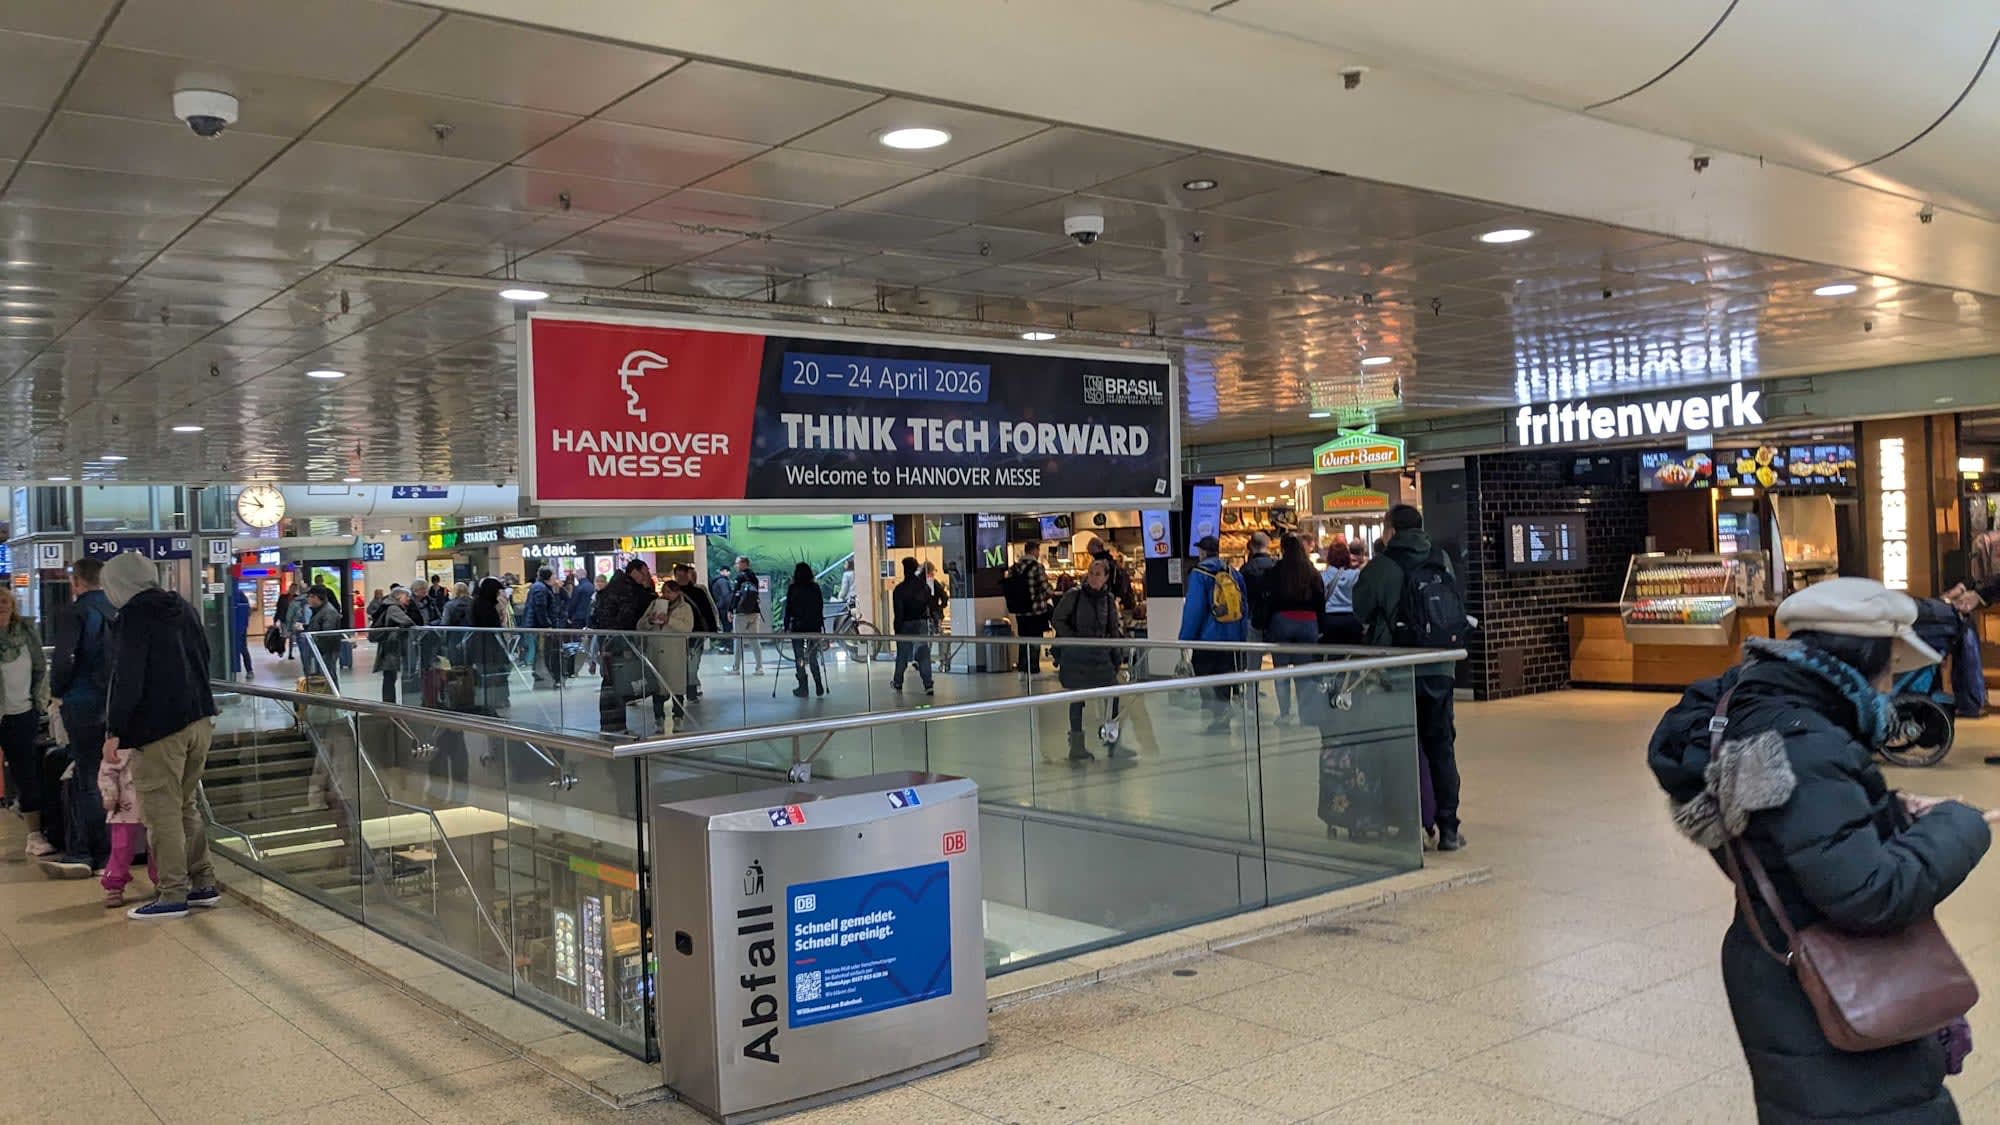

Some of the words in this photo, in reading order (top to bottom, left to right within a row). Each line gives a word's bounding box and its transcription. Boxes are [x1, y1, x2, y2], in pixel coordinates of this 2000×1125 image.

[792, 361, 819, 386] 20
[848, 364, 872, 388] 24
[879, 367, 928, 397] April
[935, 369, 982, 394] 2026
[1105, 378, 1163, 396] BRASIL
[1516, 382, 1762, 446] frittenwerk
[552, 430, 729, 455] HANNOVER
[780, 412, 897, 450] THINK
[906, 418, 990, 453] TECH
[1000, 421, 1149, 456] FORWARD
[588, 455, 701, 478] MESSE
[786, 465, 867, 486] Welcome
[872, 468, 890, 486] to
[896, 467, 990, 486] HANNOVER
[995, 468, 1040, 486] MESSE
[90, 542, 118, 554] 9-10
[215, 542, 225, 554] U
[464, 530, 498, 544] STARBUCKS
[46, 546, 58, 558] U
[531, 544, 542, 557] &
[983, 544, 1004, 568] M
[946, 834, 964, 852] DB
[796, 896, 814, 911] DB
[794, 918, 838, 936] Schnell
[840, 910, 896, 932] gemeldet.
[795, 933, 838, 952] Schnell
[840, 925, 894, 946] gereinigt.
[737, 904, 780, 1064] Abfall
